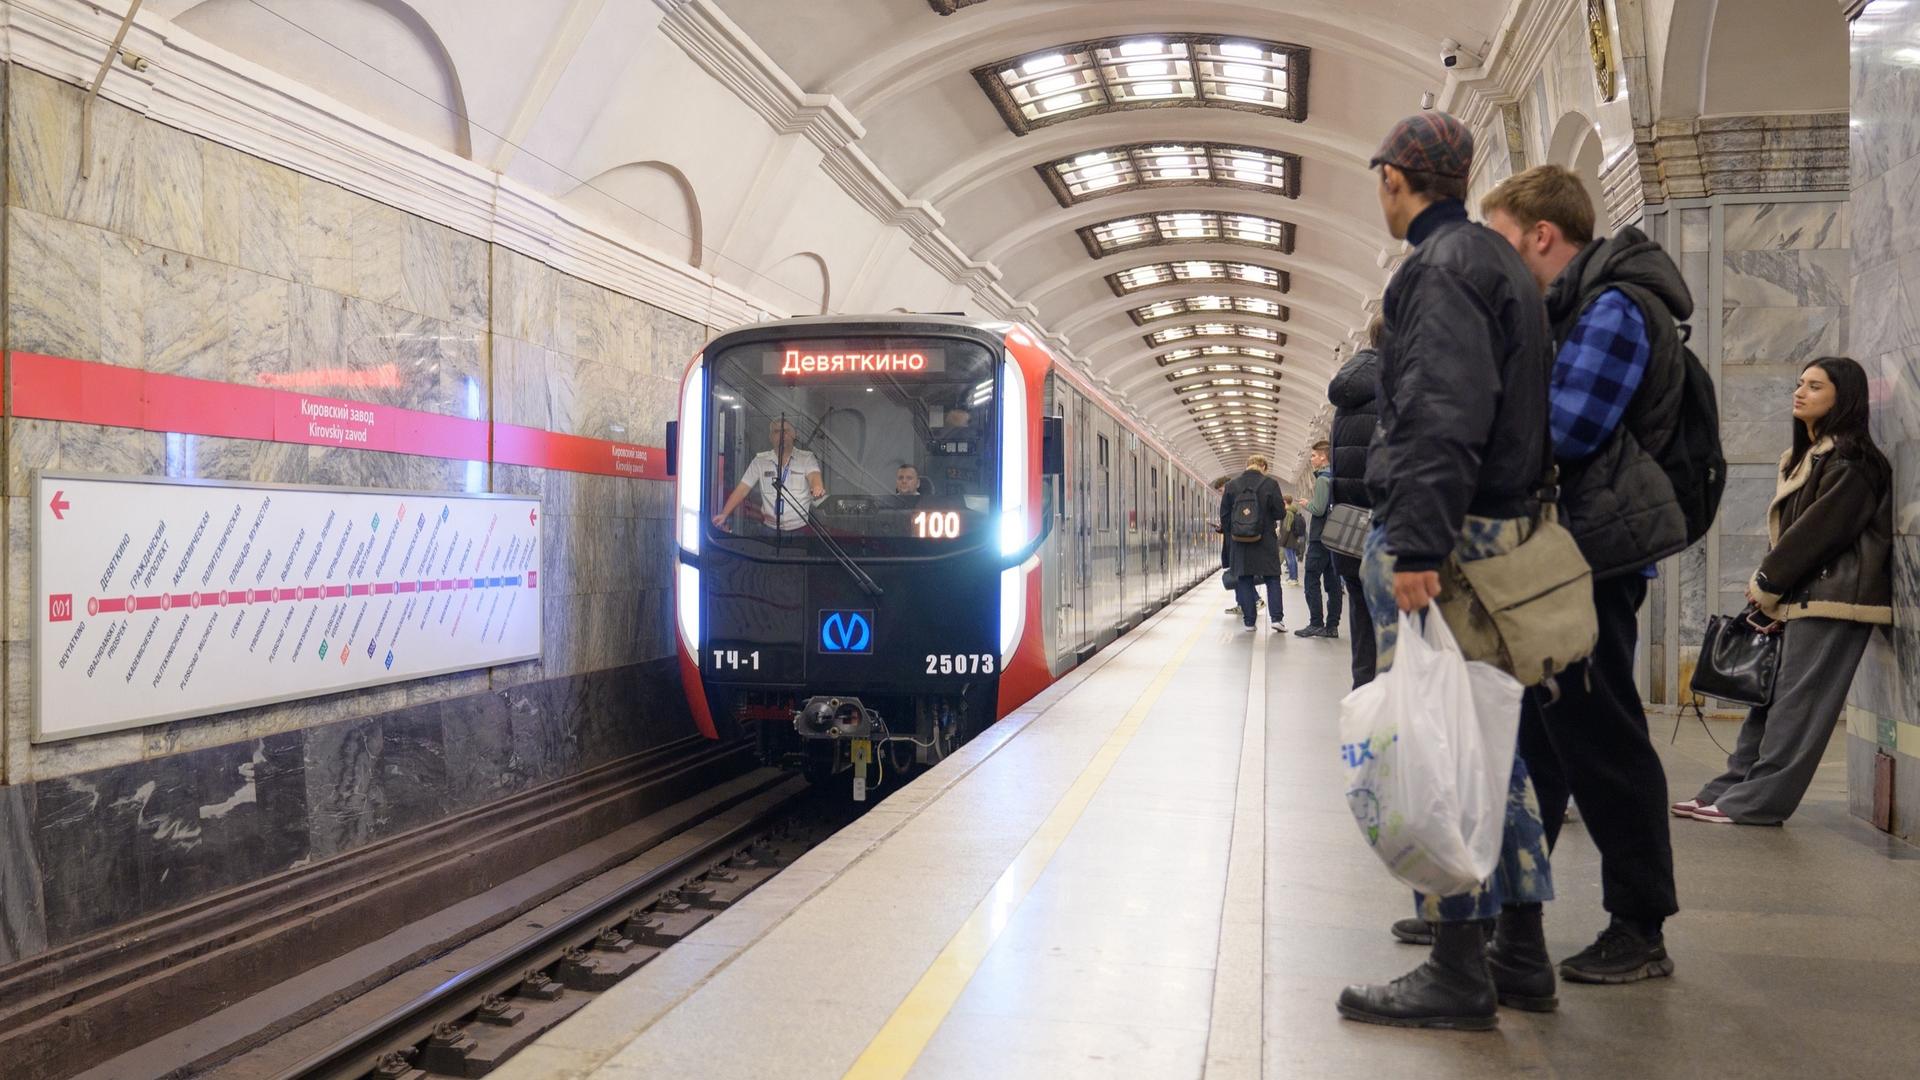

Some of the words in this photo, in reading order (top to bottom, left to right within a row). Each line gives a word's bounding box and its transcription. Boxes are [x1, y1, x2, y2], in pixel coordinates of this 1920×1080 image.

[782, 351, 924, 375] Девяткино
[301, 399, 349, 420] Кировский
[350, 408, 374, 426] завод
[309, 422, 344, 443] Kirovskiy
[345, 428, 367, 442] zavod
[172, 510, 210, 587] АКАДЕМИЧЕСКАЯ
[201, 503, 242, 587] ПОЛИТЕХНИЧЕСКАЯ
[229, 542, 250, 584] ПЛОЩАДЬ
[248, 496, 271, 543] МУЖЕСТВА
[914, 511, 960, 538] 100
[100, 533, 130, 592] ДЕВЯТКИНО
[130, 519, 167, 590] ГРАЖДАНСКИЙ
[143, 539, 169, 588] ПРОСПЕКТ
[256, 549, 272, 584] ЛЕСНАЯ
[59, 621, 86, 669] DEVYATKINO
[87, 620, 117, 678] GRAZHDANSKIY
[107, 619, 128, 659] PROSPEKT
[125, 615, 160, 684] AKADEMICHESKAYA
[713, 650, 759, 670] ТЧ-1
[925, 653, 994, 674] 25073
